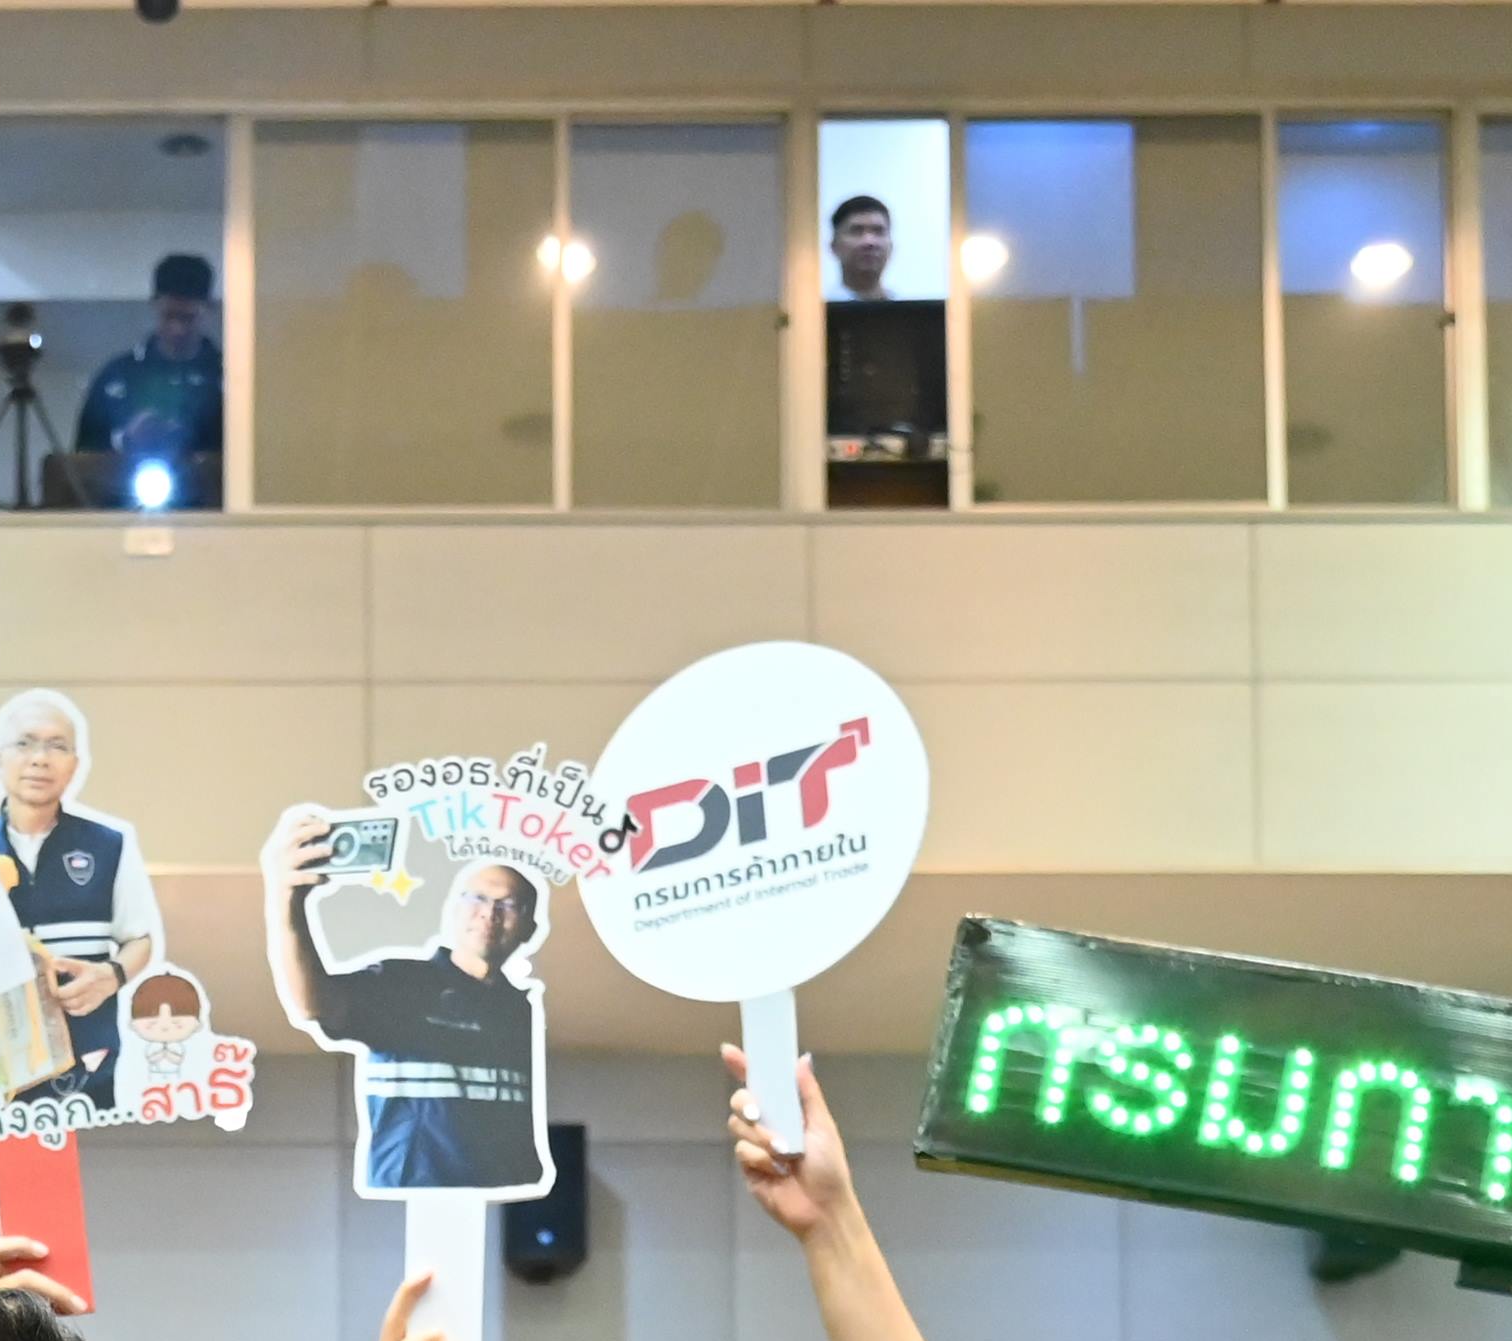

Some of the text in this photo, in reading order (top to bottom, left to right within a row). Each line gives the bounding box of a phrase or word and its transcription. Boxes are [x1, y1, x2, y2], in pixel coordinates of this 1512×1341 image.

[408, 790, 613, 879] TikToker
[634, 833, 868, 911] กรมการค้าภายใน
